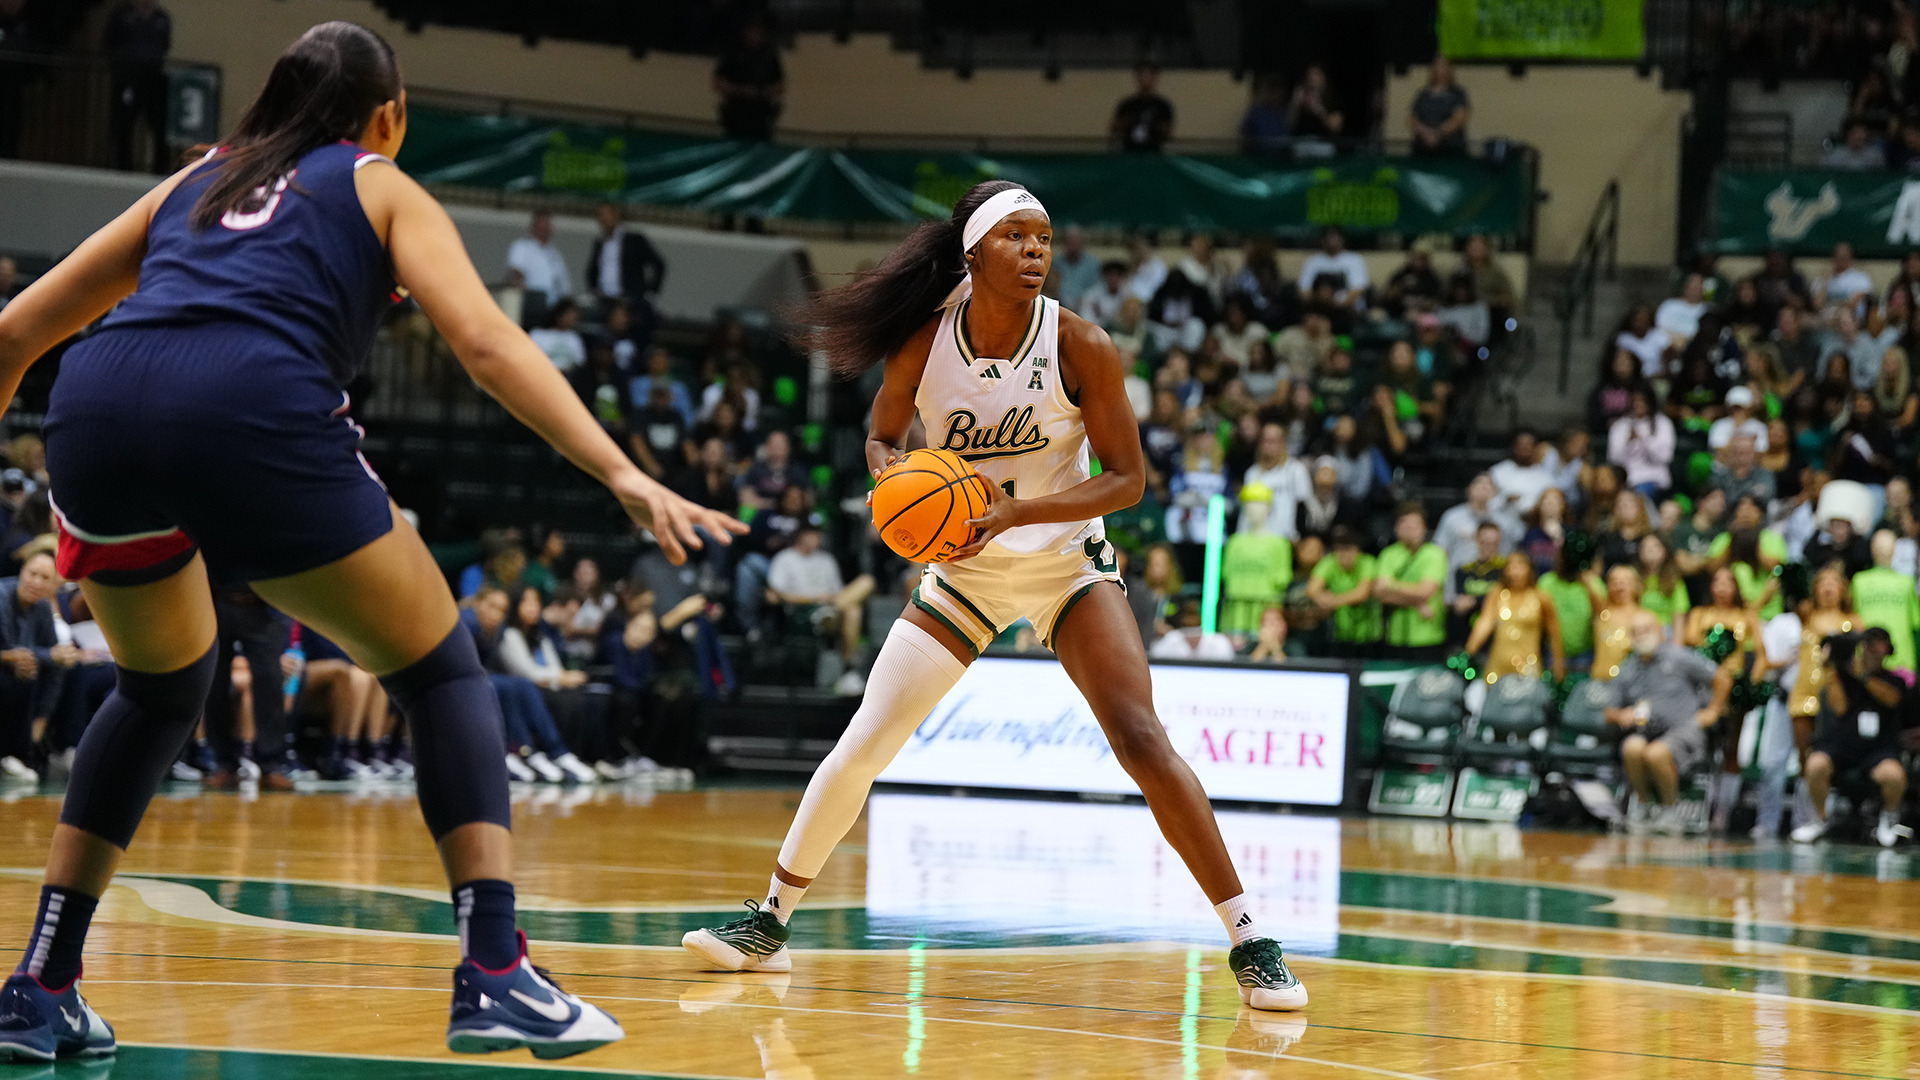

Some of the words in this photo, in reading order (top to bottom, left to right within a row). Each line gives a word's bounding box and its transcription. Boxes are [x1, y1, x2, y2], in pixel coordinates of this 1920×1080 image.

[1031, 356, 1048, 368] AAR
[938, 404, 1051, 458] Bulls
[1164, 725, 1326, 769] AGER
